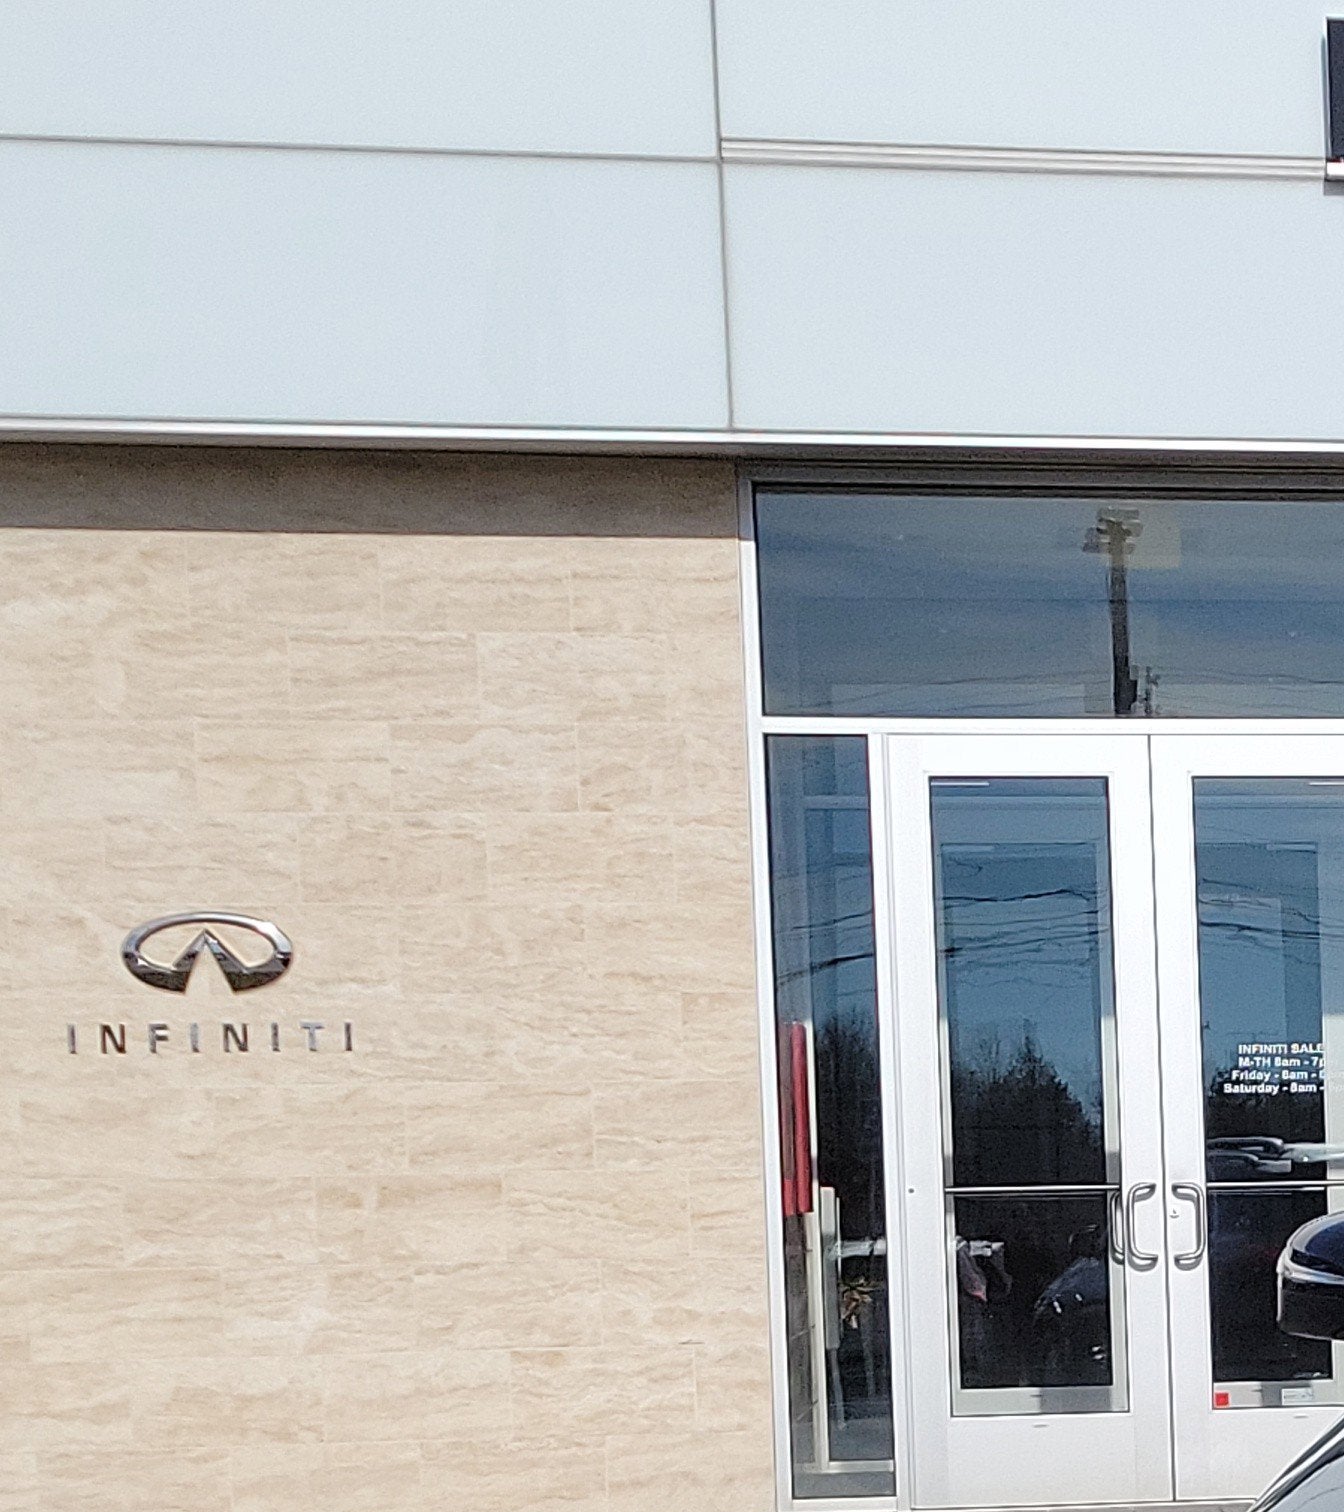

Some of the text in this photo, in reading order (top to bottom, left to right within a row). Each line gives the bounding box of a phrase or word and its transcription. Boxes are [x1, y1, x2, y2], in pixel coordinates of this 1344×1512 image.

[66, 1021, 353, 1055] INFINITI
[1238, 1042, 1327, 1055] INFINITI SALE
[1231, 1069, 1271, 1082] Friday
[1223, 1082, 1280, 1096] Saturday
